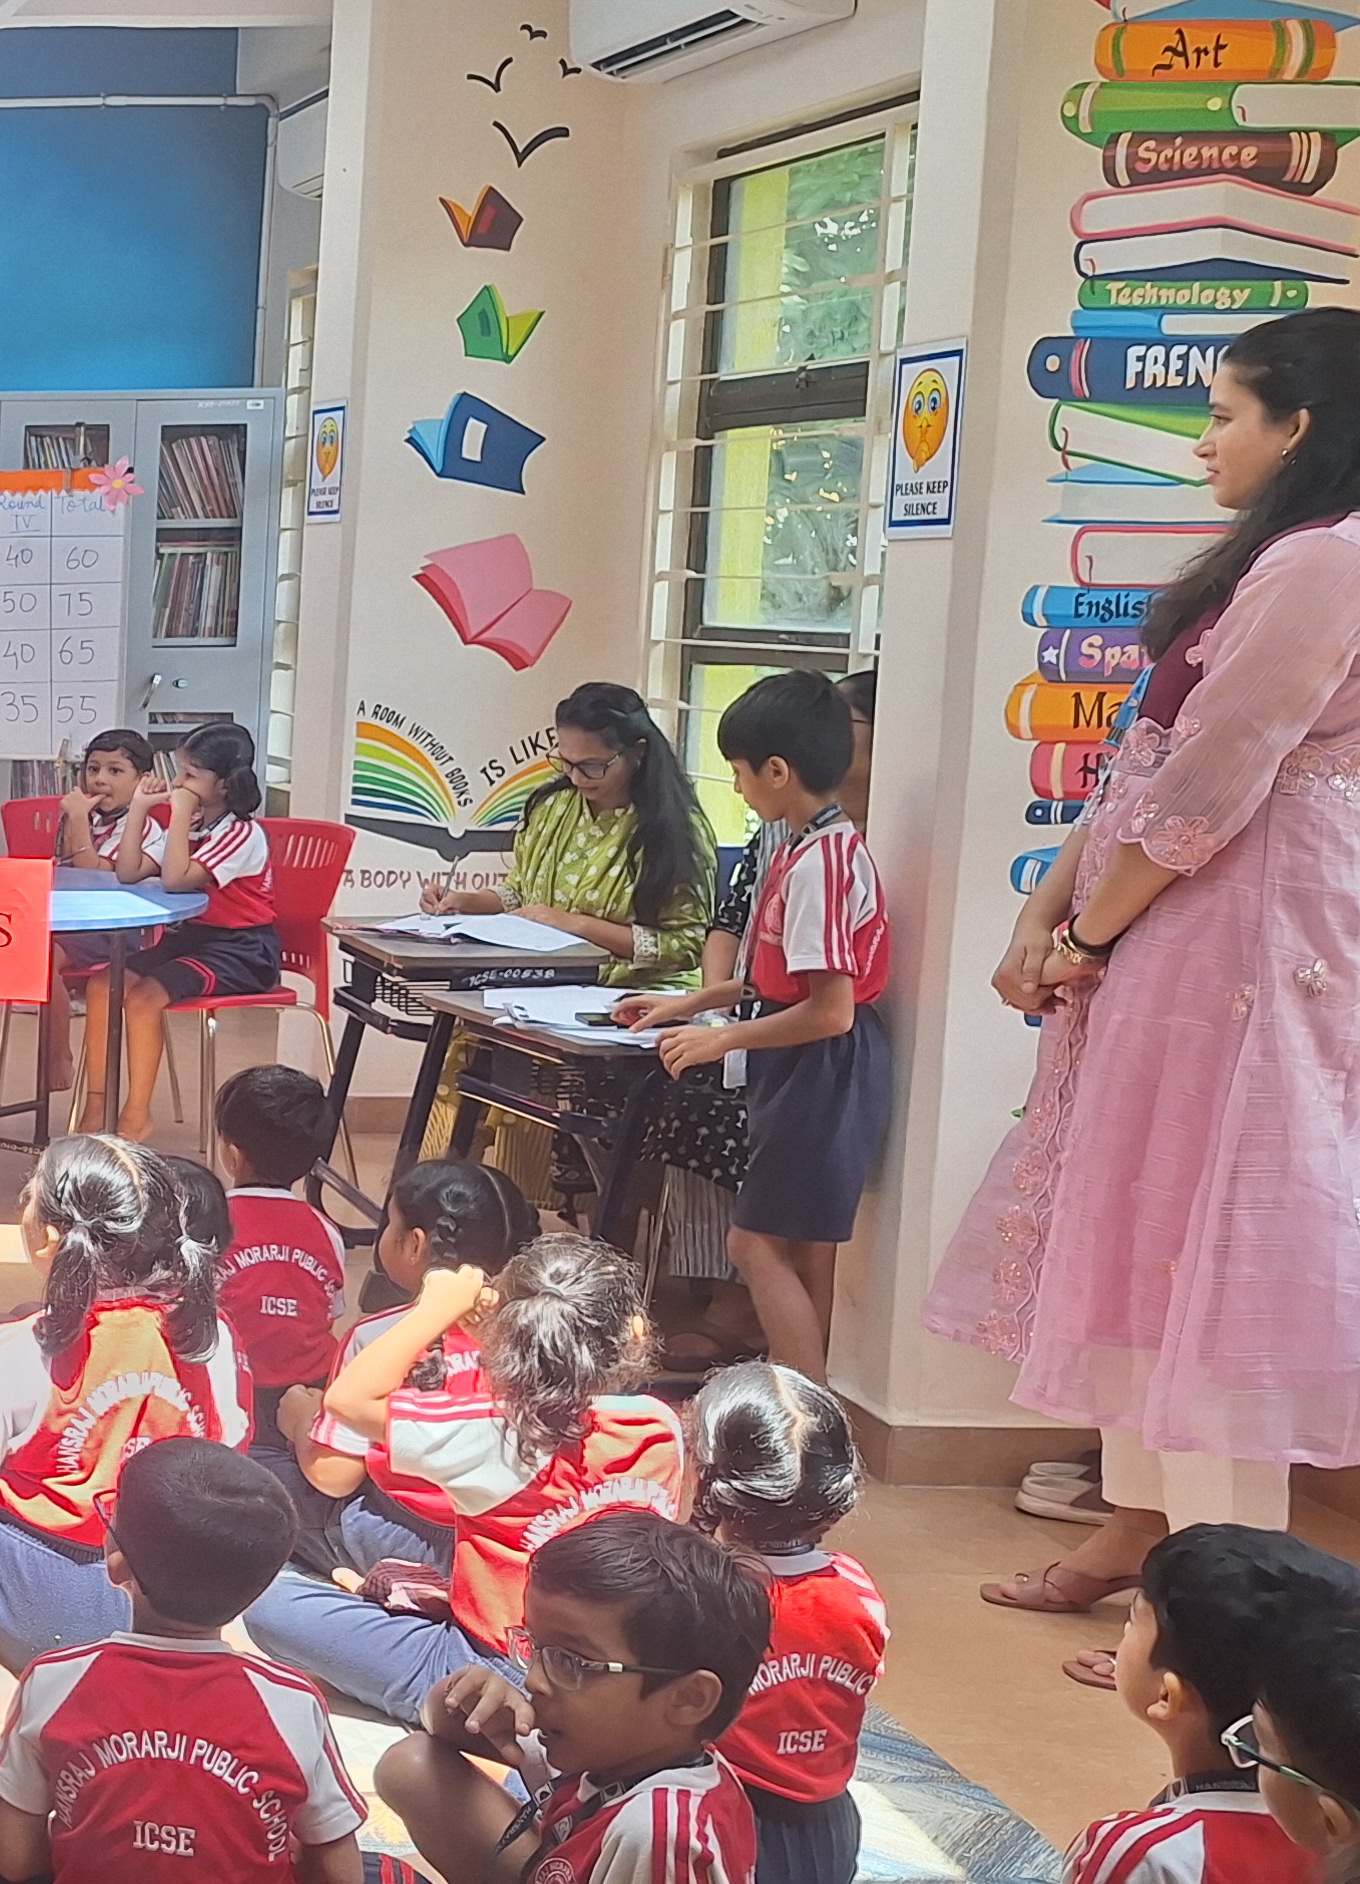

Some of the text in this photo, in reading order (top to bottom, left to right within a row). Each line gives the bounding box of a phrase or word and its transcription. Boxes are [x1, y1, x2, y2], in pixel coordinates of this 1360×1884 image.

[1152, 27, 1229, 76] Art
[1134, 137, 1259, 174] Science
[1105, 281, 1252, 309] Technology
[54, 493, 106, 514] Total
[895, 479, 949, 497] PLEASE KEEP
[903, 502, 938, 516] SILENCE
[5, 547, 34, 568] 40
[65, 547, 99, 569] 60
[2, 591, 37, 614] 50
[58, 592, 94, 617] 75
[1072, 592, 1147, 623] Englis
[3, 641, 36, 671] 40
[59, 638, 96, 665] 65
[1, 690, 39, 723] 35
[56, 694, 97, 724] 55
[356, 699, 559, 808] A ROOM WITHOUT BOOKS IS LIKE
[343, 869, 355, 889] A
[360, 869, 412, 890] BODY
[233, 1244, 290, 1270] MORARJI
[291, 1249, 328, 1282] PUBLIC
[260, 1295, 298, 1317] ICSE
[57, 1406, 97, 1474] HANSRAJ
[519, 1496, 580, 1552] HANSRAJ
[747, 1652, 878, 1696] MORARJI PUBLIC
[776, 1728, 829, 1755] ICSE
[57, 1730, 291, 1863] HANSRAJ MORARJI PUBLIC SCHOOL
[132, 1820, 196, 1858] ICSE
